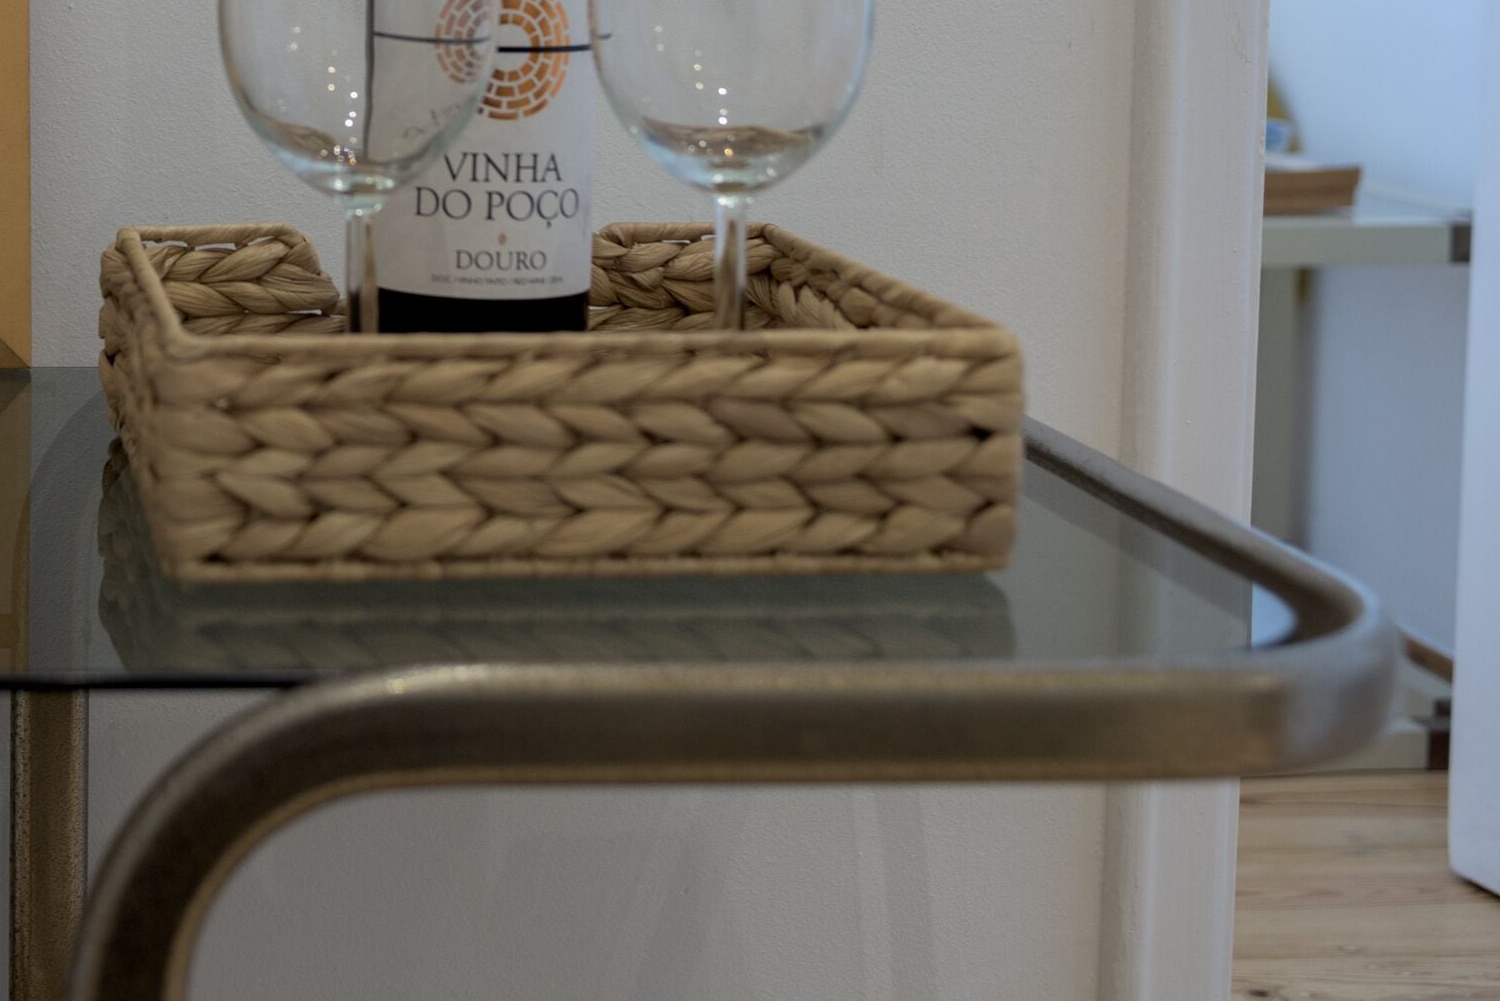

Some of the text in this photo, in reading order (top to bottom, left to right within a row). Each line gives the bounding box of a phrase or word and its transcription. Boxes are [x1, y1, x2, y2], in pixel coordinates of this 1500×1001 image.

[444, 152, 562, 183] VINHA
[414, 186, 579, 229] DO POÇO
[456, 250, 547, 271] DOURO
